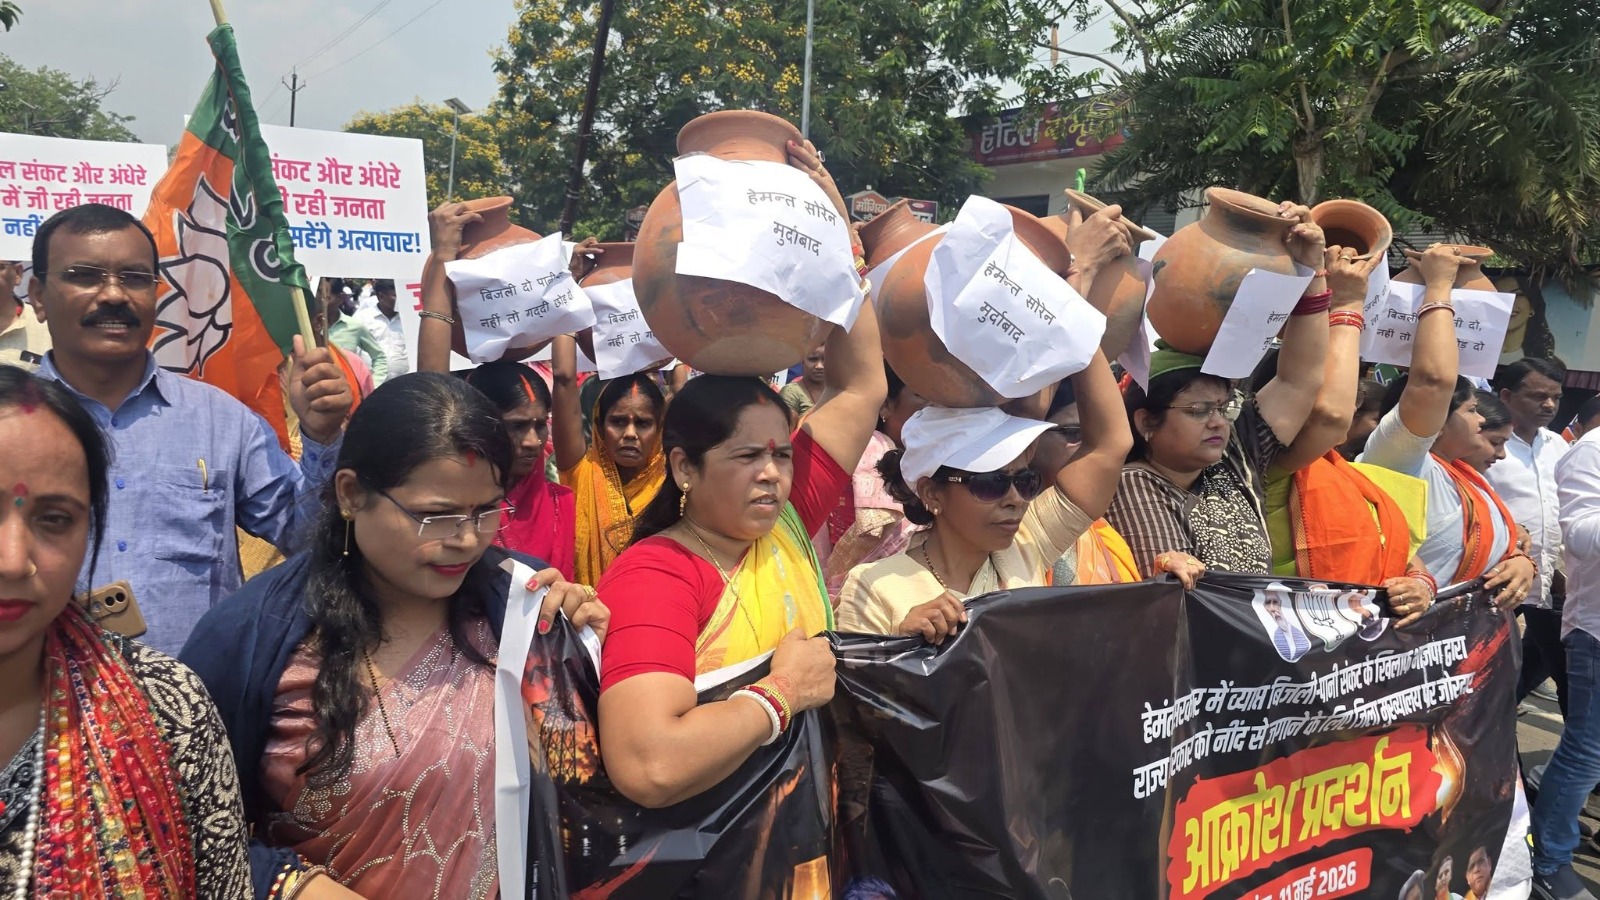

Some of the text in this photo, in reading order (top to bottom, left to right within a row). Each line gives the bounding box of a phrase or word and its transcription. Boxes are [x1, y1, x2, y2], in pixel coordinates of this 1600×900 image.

[20, 159, 67, 183] संकट
[73, 162, 104, 184] और
[109, 164, 147, 187] अंधेरे
[317, 157, 353, 186] और
[359, 161, 401, 190] अंधेरे
[24, 186, 48, 209] जी
[292, 189, 327, 216] रही
[330, 197, 385, 220] जनता
[747, 189, 837, 226] हेमन्त सोरेन
[288, 221, 421, 254] सहेंगे अत्याचार!
[773, 221, 822, 256] मुर्दाबाद
[480, 284, 517, 302] बिजली
[522, 278, 533, 293] दो
[984, 261, 1057, 325] हेमन्त सोरेन
[480, 312, 500, 329] नहीं
[507, 310, 520, 325] तो
[608, 308, 639, 325] बिजली
[977, 301, 1025, 344] मुर्दाबाद
[1387, 308, 1418, 323] बिजली
[607, 333, 624, 347] नहीं
[629, 331, 641, 343] तो
[1376, 328, 1395, 339] नहीं
[1400, 331, 1412, 342] तो
[1473, 341, 1485, 352] दो
[1141, 701, 1174, 744] हेमंत
[1205, 680, 1234, 713] में
[1340, 660, 1364, 695] संकट
[1362, 655, 1375, 686] के
[1375, 650, 1414, 683] खिलाफ
[1442, 635, 1468, 667] द्वारा
[1133, 757, 1169, 799] राज्य
[1194, 722, 1214, 760] को
[1213, 720, 1250, 753] नींद
[1248, 717, 1269, 750] से
[1303, 710, 1327, 736] के
[1350, 698, 1381, 729] जिला
[1379, 689, 1422, 728] मुख्यालय
[1422, 681, 1438, 709] पर
[1183, 736, 1412, 895] आक्रोश प्रदर्शन
[1291, 867, 1316, 900] मई
[1317, 861, 1357, 896] 2026
